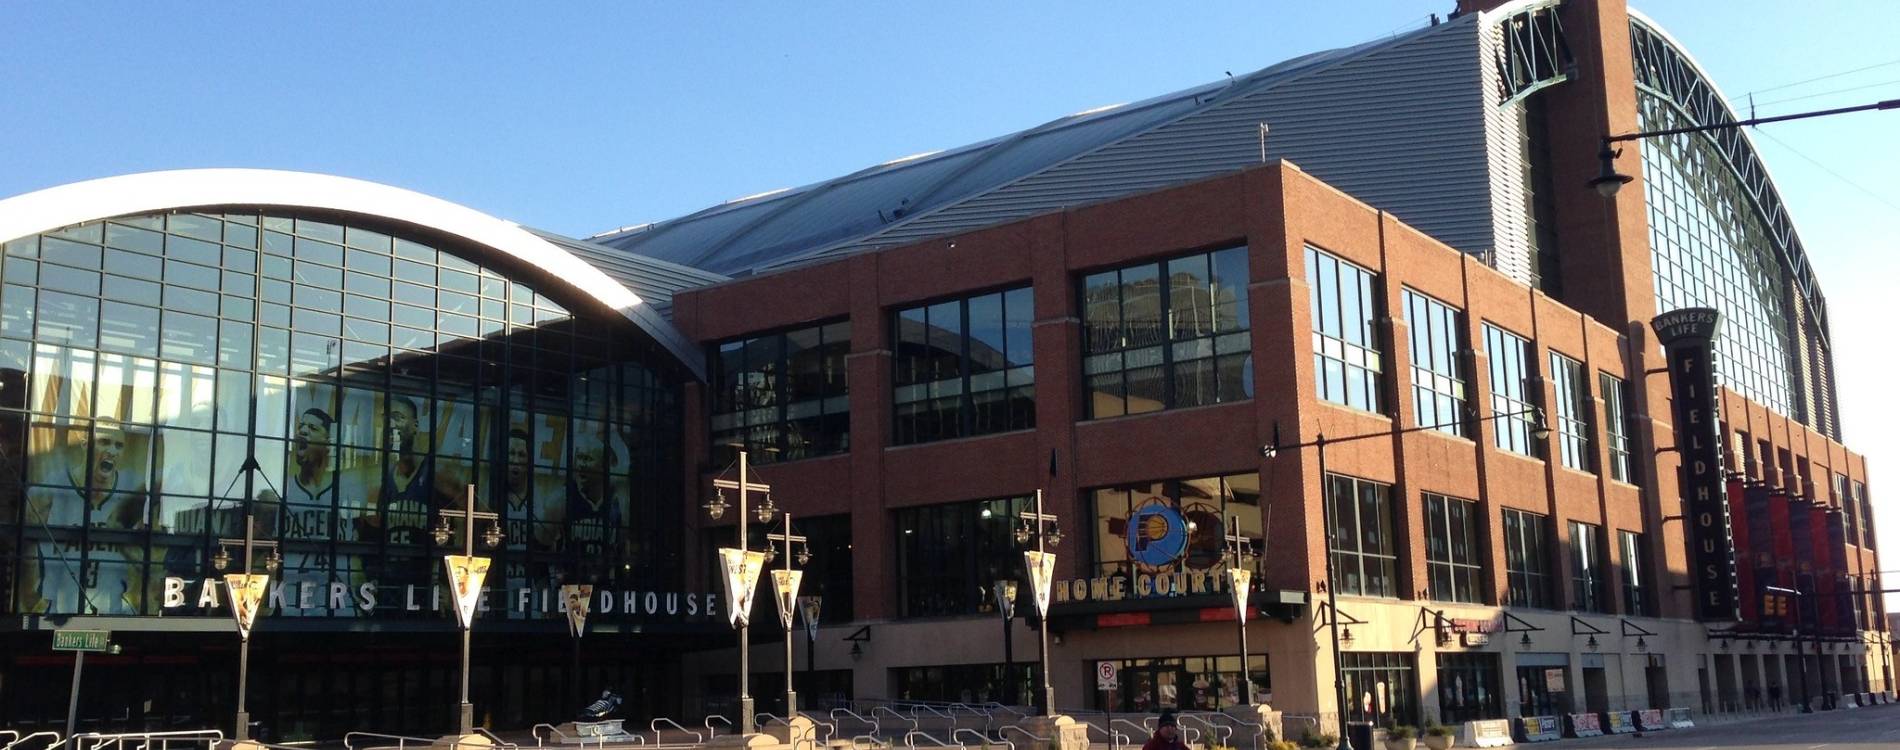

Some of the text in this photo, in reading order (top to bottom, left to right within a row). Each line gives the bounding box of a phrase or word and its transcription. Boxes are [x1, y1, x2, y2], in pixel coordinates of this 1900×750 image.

[1655, 311, 1714, 331] BANKERS
[1671, 322, 1698, 337] LIFE
[1684, 359, 1721, 606] FIELDHOUSE
[162, 576, 718, 617] BAKERS LIE FIEDHOUSE
[1055, 569, 1226, 602] HOME COURT
